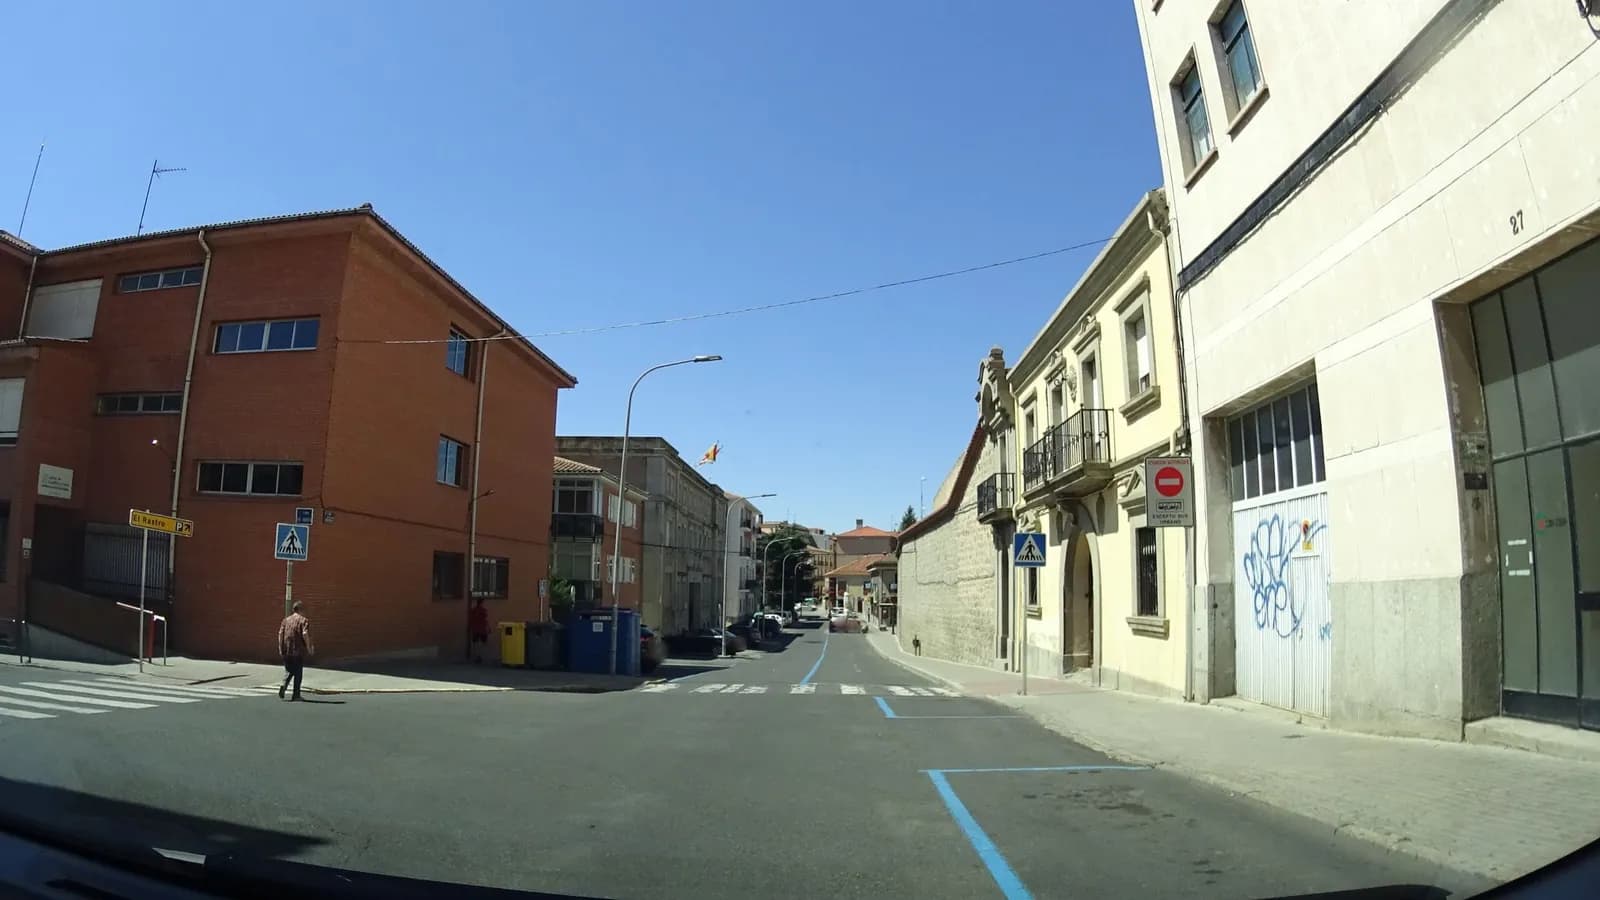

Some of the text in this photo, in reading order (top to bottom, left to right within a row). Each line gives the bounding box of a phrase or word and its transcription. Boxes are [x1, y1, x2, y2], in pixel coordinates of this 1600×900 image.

[1509, 209, 1524, 235] 27
[133, 514, 141, 522] El
[143, 516, 166, 528] Rastro
